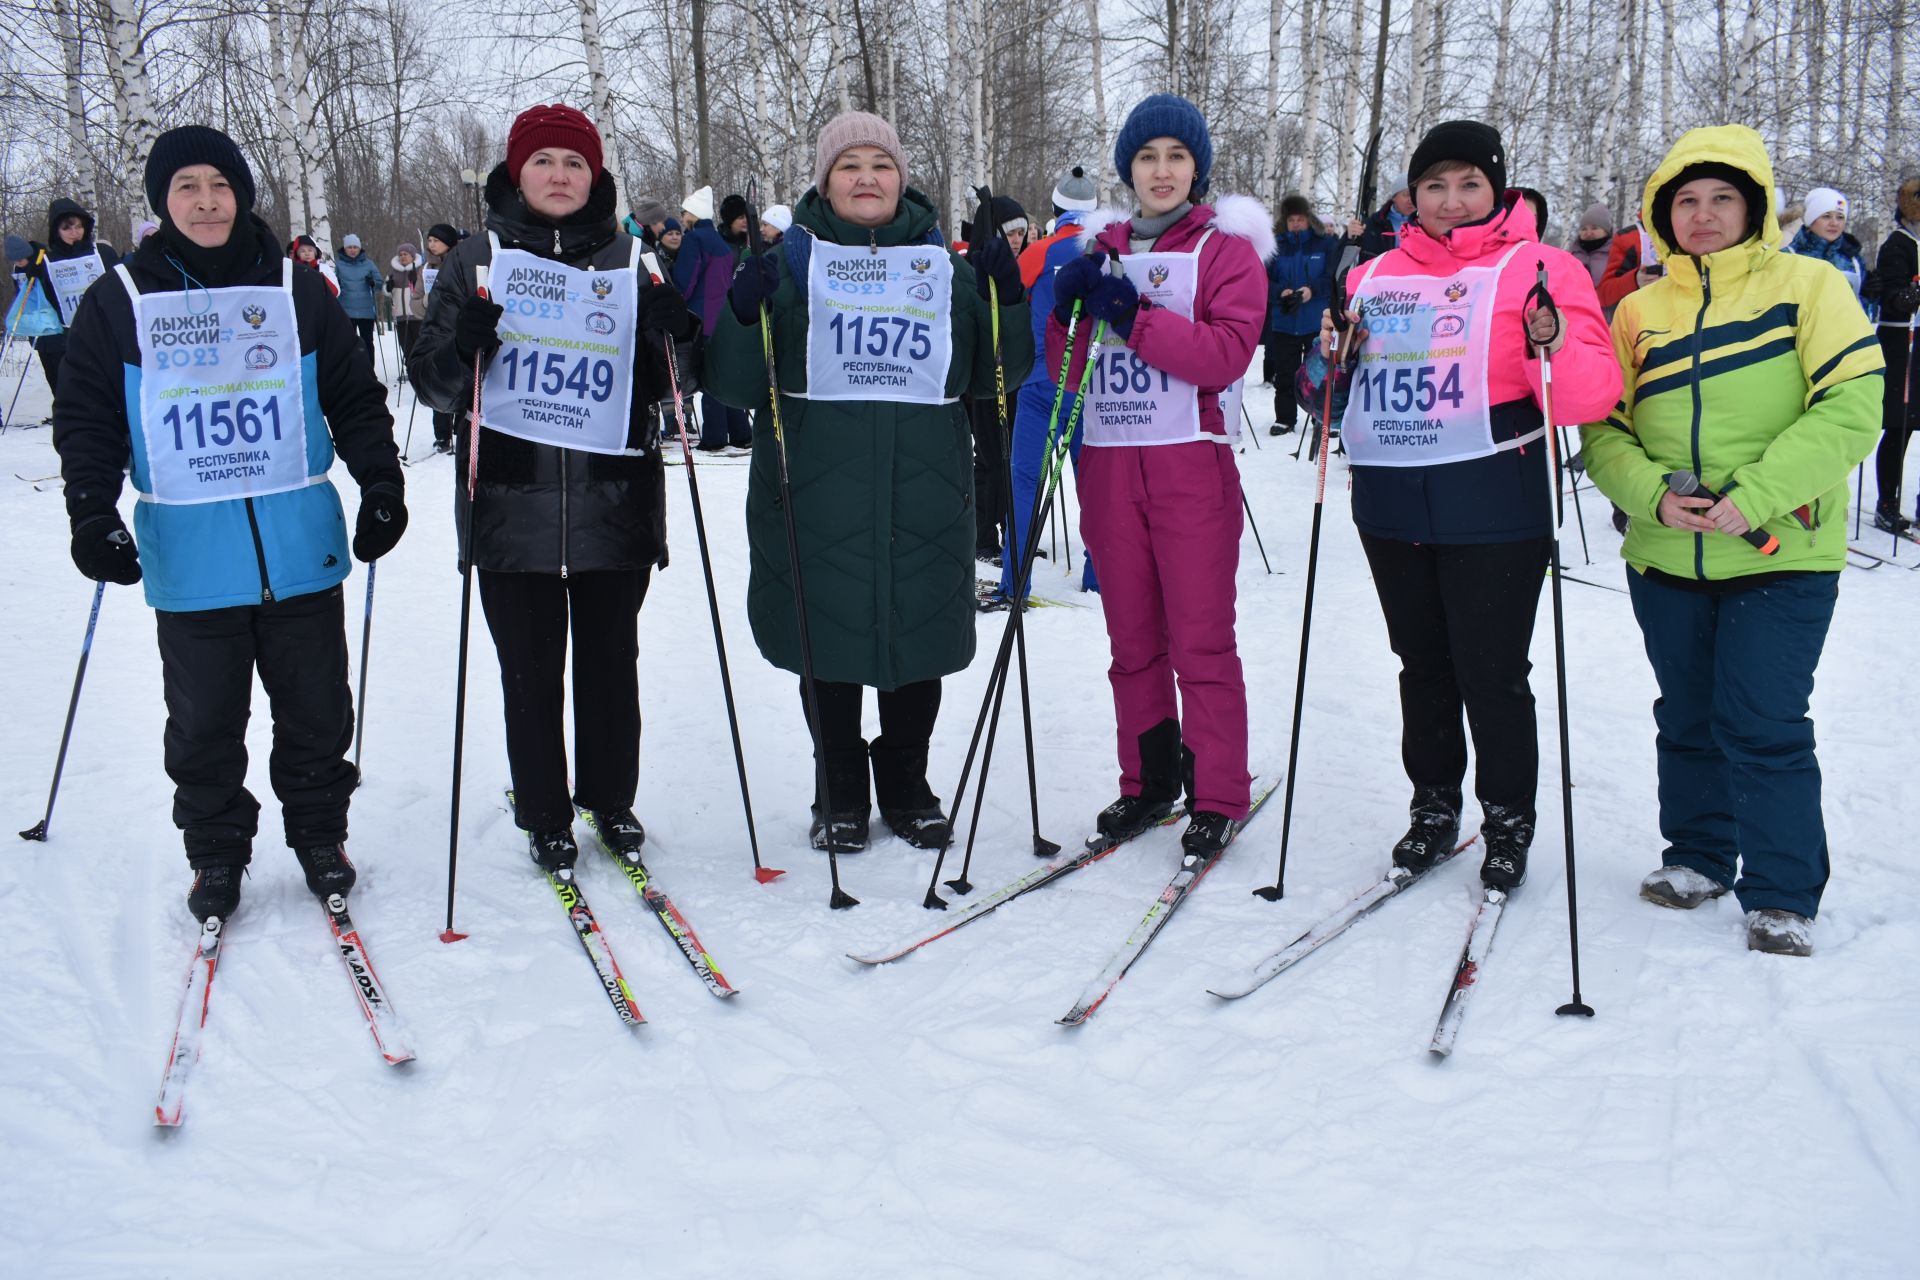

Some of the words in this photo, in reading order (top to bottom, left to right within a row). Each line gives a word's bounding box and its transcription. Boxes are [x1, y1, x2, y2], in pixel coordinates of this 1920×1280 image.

[826, 258, 886, 272] ЛЫЖНЯ
[506, 267, 567, 286] ЛЫЖНЯ
[827, 270, 886, 282] РОССИИ
[506, 282, 566, 302] РОССИИ
[827, 279, 886, 295] 2023
[1365, 290, 1421, 306] ЛЫЖНЯ
[504, 298, 564, 320] 2023
[902, 304, 936, 320] ЖИЗНИ
[1363, 302, 1417, 317] РОССИИ
[150, 312, 220, 332] ЛЫЖНЯ
[151, 328, 220, 348] РОССИИ
[501, 330, 532, 345] СПОРТ
[540, 336, 580, 351] НОРМА
[581, 341, 619, 356] ЖИЗНИ
[830, 312, 932, 360] 11575
[155, 347, 220, 370] 2023
[1388, 351, 1424, 362] НОРМА
[1426, 346, 1467, 360] ЖИЗНИ
[502, 347, 614, 402] 11549
[843, 361, 914, 375] РЕСПУБЛИКА
[200, 383, 243, 397] НОРМА
[243, 378, 286, 392] ЖИЗНИ
[847, 374, 907, 387] ТАТАРСТАН
[1359, 362, 1464, 412] 11554
[1066, 381, 1088, 438] Sable
[1095, 400, 1157, 413] РЕСПУБЛИКА
[163, 395, 282, 451] 11561
[522, 408, 583, 429] ТАТАРСТАН
[1099, 414, 1152, 426] ТАТАРСТАН
[1373, 418, 1444, 432] РЕСПУБЛИКА
[1378, 434, 1438, 446] ТАТАРСТАН
[189, 450, 271, 469] РЕСПУБЛИКА
[197, 465, 266, 483] ТАТАРСТАН
[1186, 824, 1213, 839] 94
